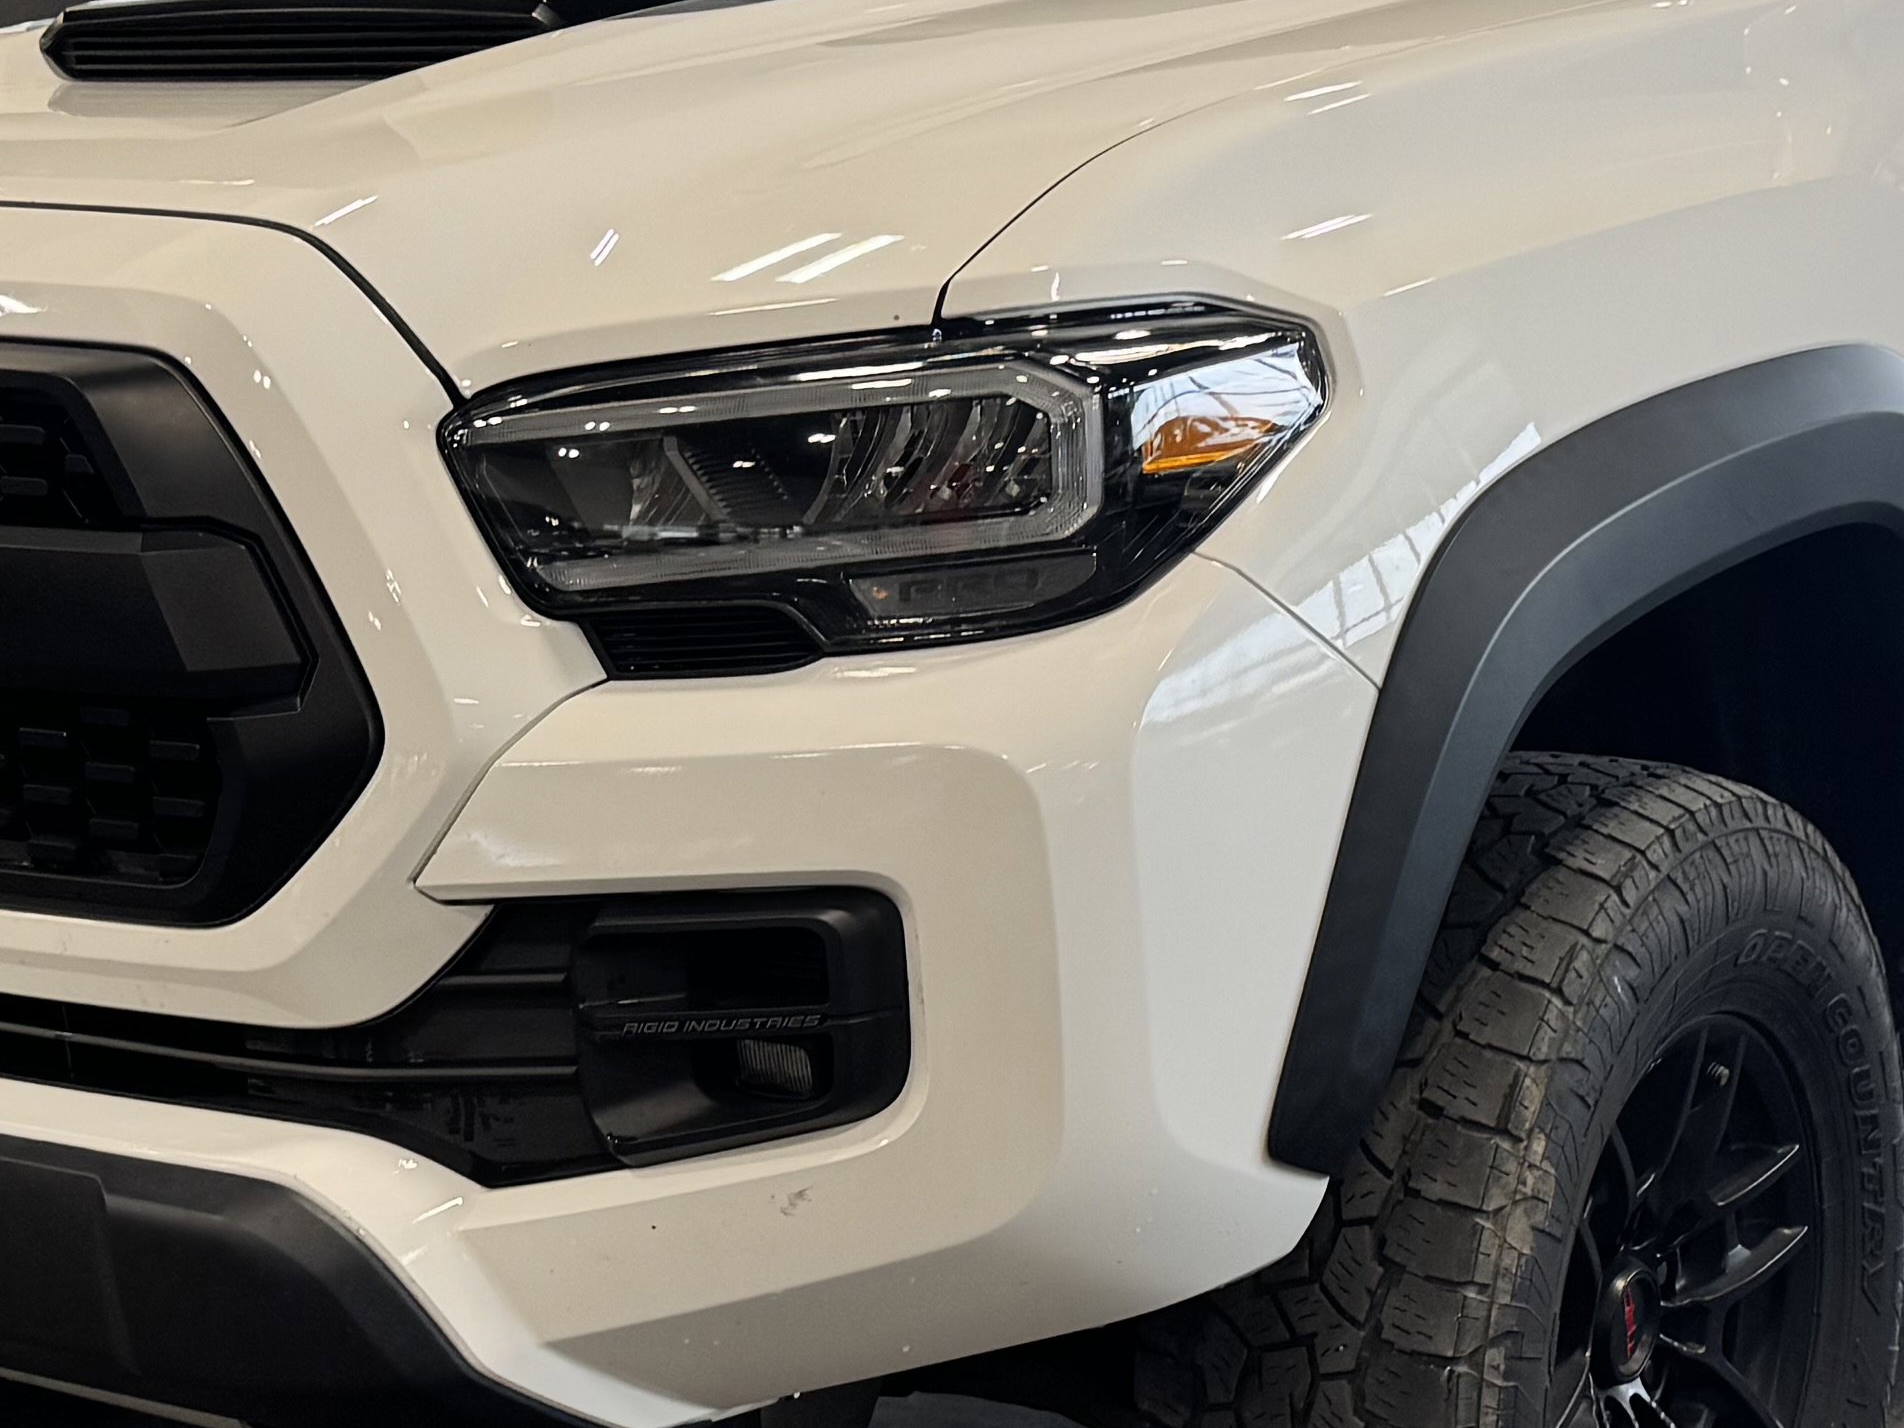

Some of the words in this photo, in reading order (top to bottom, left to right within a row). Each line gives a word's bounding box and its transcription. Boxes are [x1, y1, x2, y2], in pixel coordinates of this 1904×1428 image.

[622, 1020, 679, 1035] RIGID
[683, 1014, 822, 1033] INDUSTRIES
[1823, 992, 1893, 1316] COUNTRY
